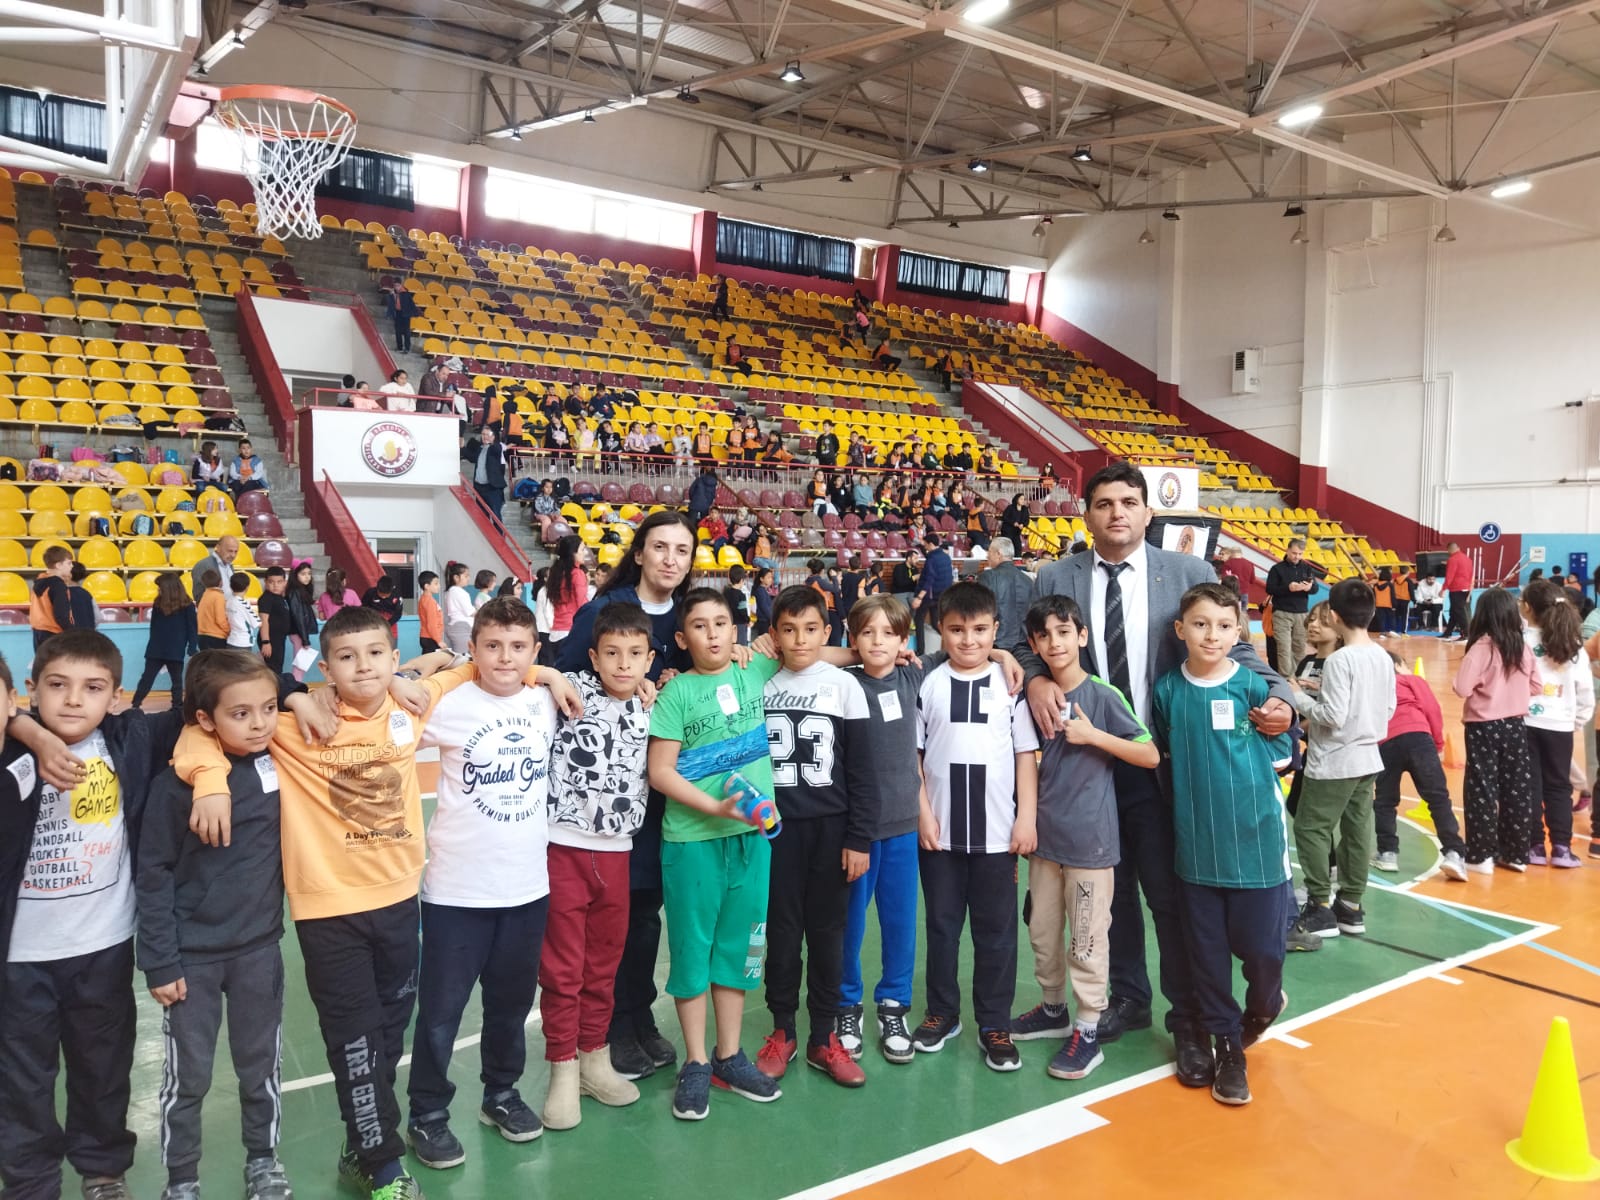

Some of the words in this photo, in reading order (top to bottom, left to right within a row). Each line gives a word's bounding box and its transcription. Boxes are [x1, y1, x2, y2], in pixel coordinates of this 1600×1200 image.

[463, 723, 494, 759] ORIGINAL
[507, 717, 532, 728] VINTA
[684, 714, 720, 746] PORT
[498, 747, 531, 755] AUTHENTIC
[764, 714, 835, 788] 23
[462, 761, 516, 794] Graded
[88, 778, 109, 797] MY
[41, 792, 61, 805] GBY
[75, 795, 118, 819] GAME!
[37, 807, 54, 821] OLF
[473, 798, 511, 822] PREMIUM
[516, 799, 541, 822] QUALITY
[36, 819, 68, 834] ENNIS
[353, 832, 368, 840] Day
[24, 873, 93, 889] BASKETBALL
